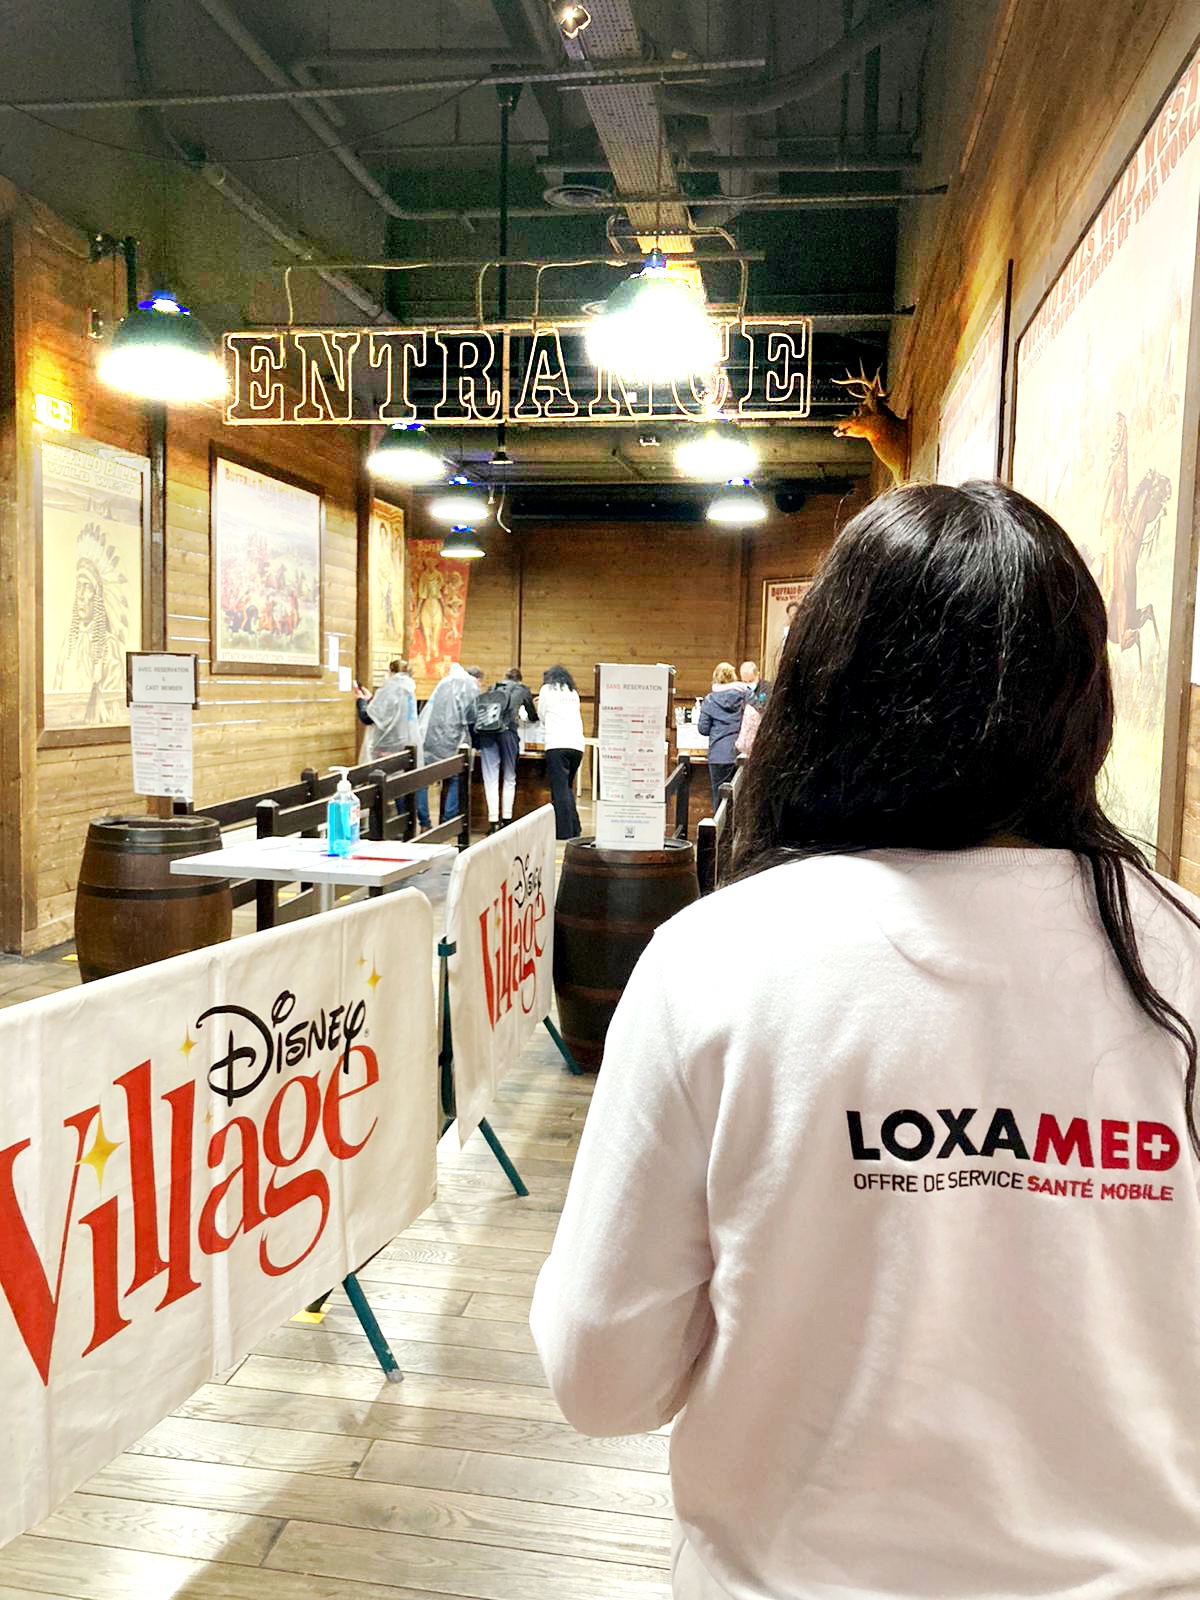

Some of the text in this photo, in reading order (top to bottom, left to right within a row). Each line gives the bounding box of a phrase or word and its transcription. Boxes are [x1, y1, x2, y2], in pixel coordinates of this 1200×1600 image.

[1100, 152, 1139, 246] WILD
[1144, 58, 1200, 178] WEST
[1116, 206, 1132, 250] OF
[1133, 165, 1159, 225] THE
[1159, 102, 1200, 185] WORL
[478, 879, 547, 1032] Village
[846, 1107, 1181, 1172] LOXAMED
[853, 1170, 1174, 1202] OFFRE DE SERVICE SANTÉ MOBILE
[0, 1045, 380, 1387] Village
